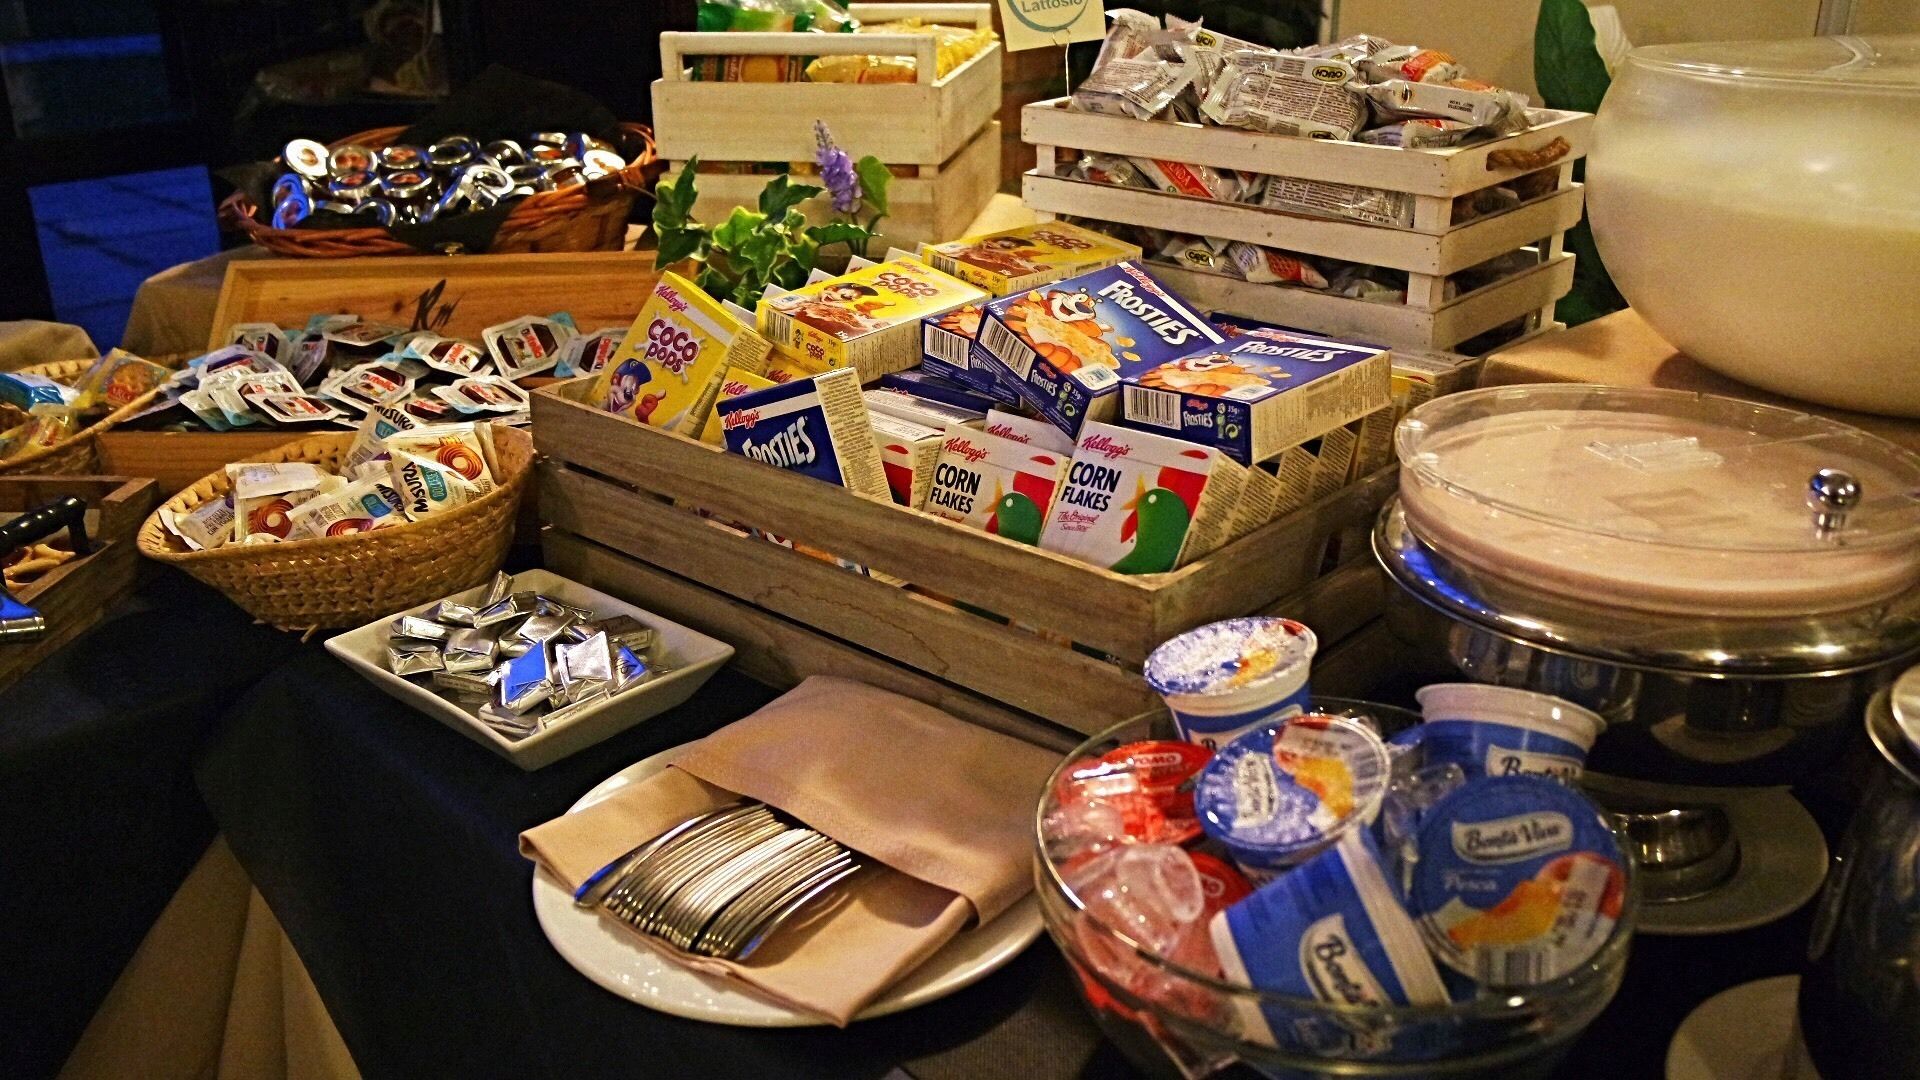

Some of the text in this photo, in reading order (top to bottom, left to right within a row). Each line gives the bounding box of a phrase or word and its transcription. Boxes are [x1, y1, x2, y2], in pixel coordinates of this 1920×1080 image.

[656, 285, 688, 312] Kellogg's
[1097, 279, 1201, 346] FROSTIES
[1230, 341, 1347, 363] FROSTIES
[1030, 369, 1058, 397] FROSTIES
[725, 408, 761, 431] Kellogg's
[1183, 410, 1214, 429] FROSTIES
[944, 436, 990, 463] Kellogg's
[1081, 434, 1131, 459] Kellogg's
[402, 461, 429, 513] MISURA
[935, 462, 982, 496] CORN
[1068, 461, 1122, 494] CORN
[929, 486, 974, 515] FLAKES
[1060, 486, 1112, 512] FLAKES
